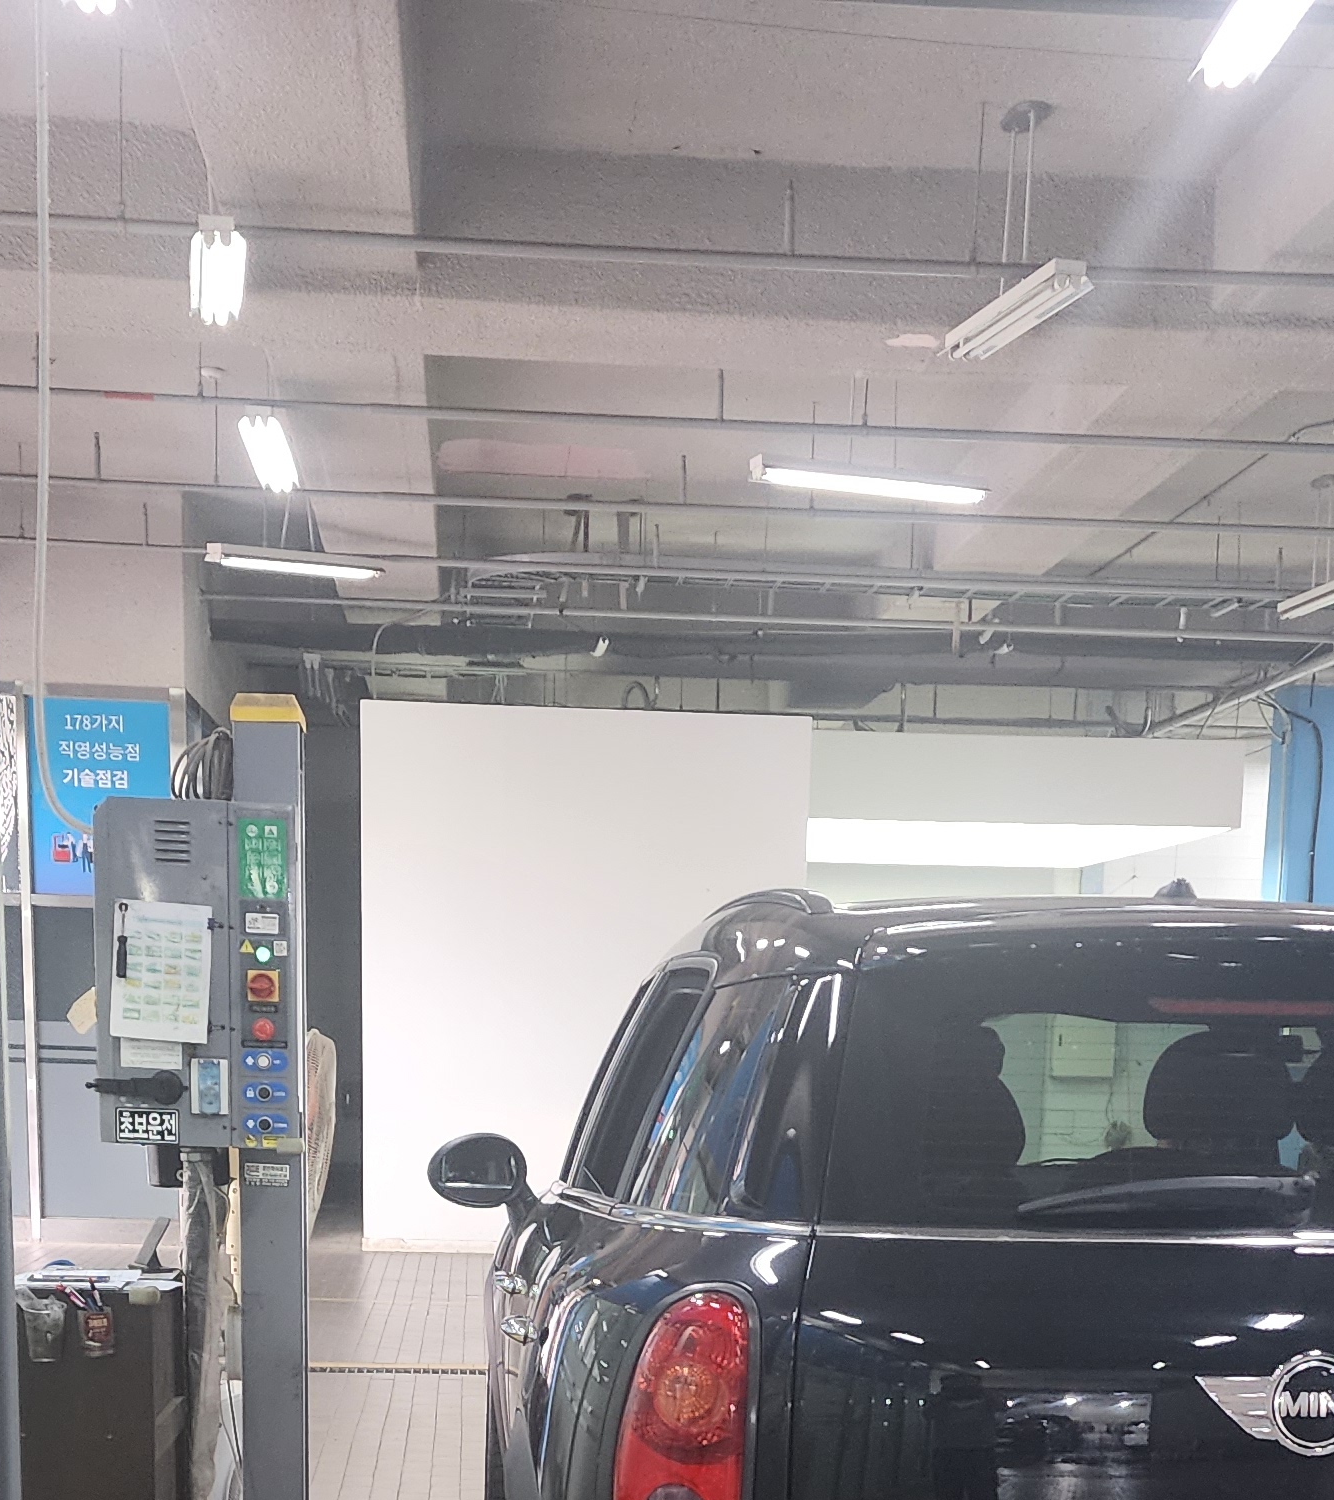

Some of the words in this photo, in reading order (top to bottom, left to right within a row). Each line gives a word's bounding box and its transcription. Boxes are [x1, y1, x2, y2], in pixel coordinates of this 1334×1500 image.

[64, 713, 124, 733] 178가지
[58, 740, 140, 762] 직영성능점
[62, 768, 128, 789] 기술점검
[119, 1111, 176, 1141] 초보운전
